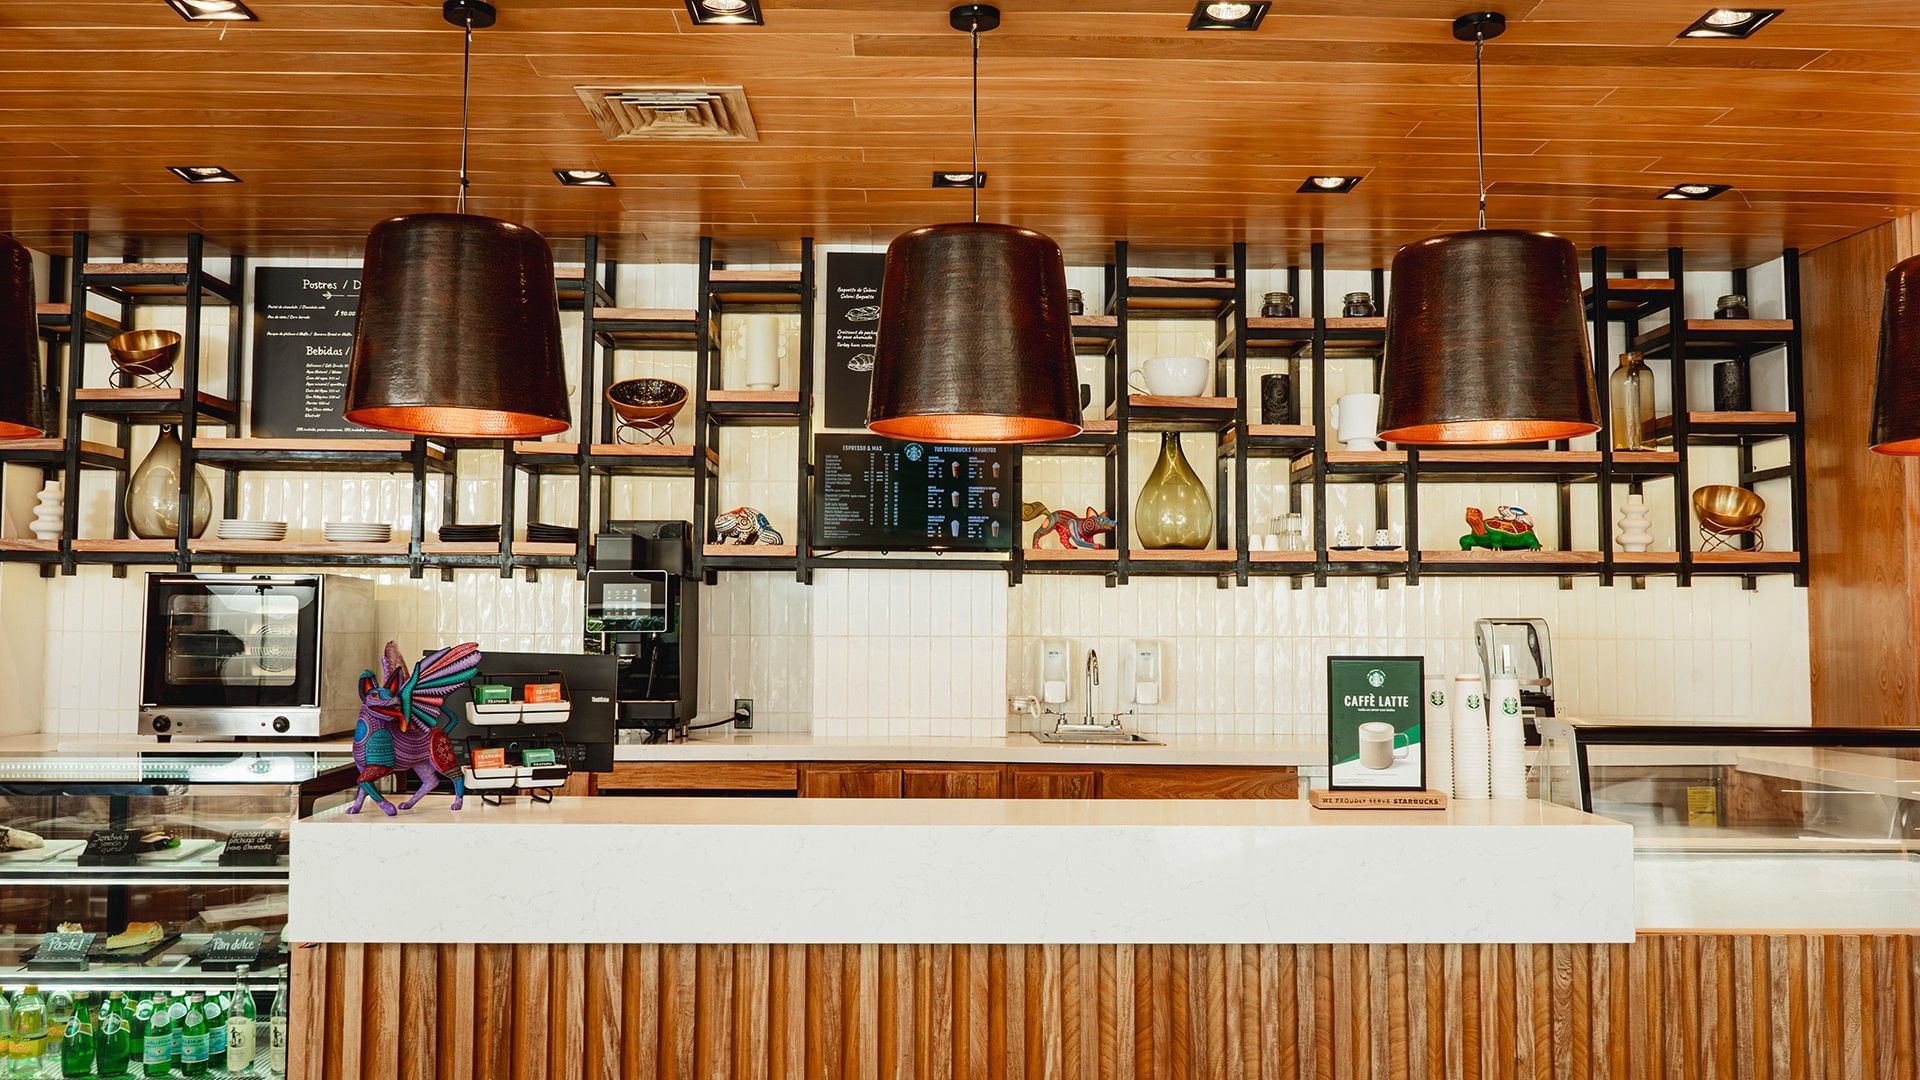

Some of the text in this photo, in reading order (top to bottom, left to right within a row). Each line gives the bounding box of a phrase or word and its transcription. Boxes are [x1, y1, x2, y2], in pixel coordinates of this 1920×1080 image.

[303, 279, 337, 290] Postres
[343, 280, 348, 290] /
[306, 346, 350, 356] Bebidas /
[1344, 693, 1409, 707] CAFFÈ LATTE
[95, 832, 129, 842] Sandwich
[48, 936, 84, 951] Pastel
[213, 937, 254, 951] Pan dulce
